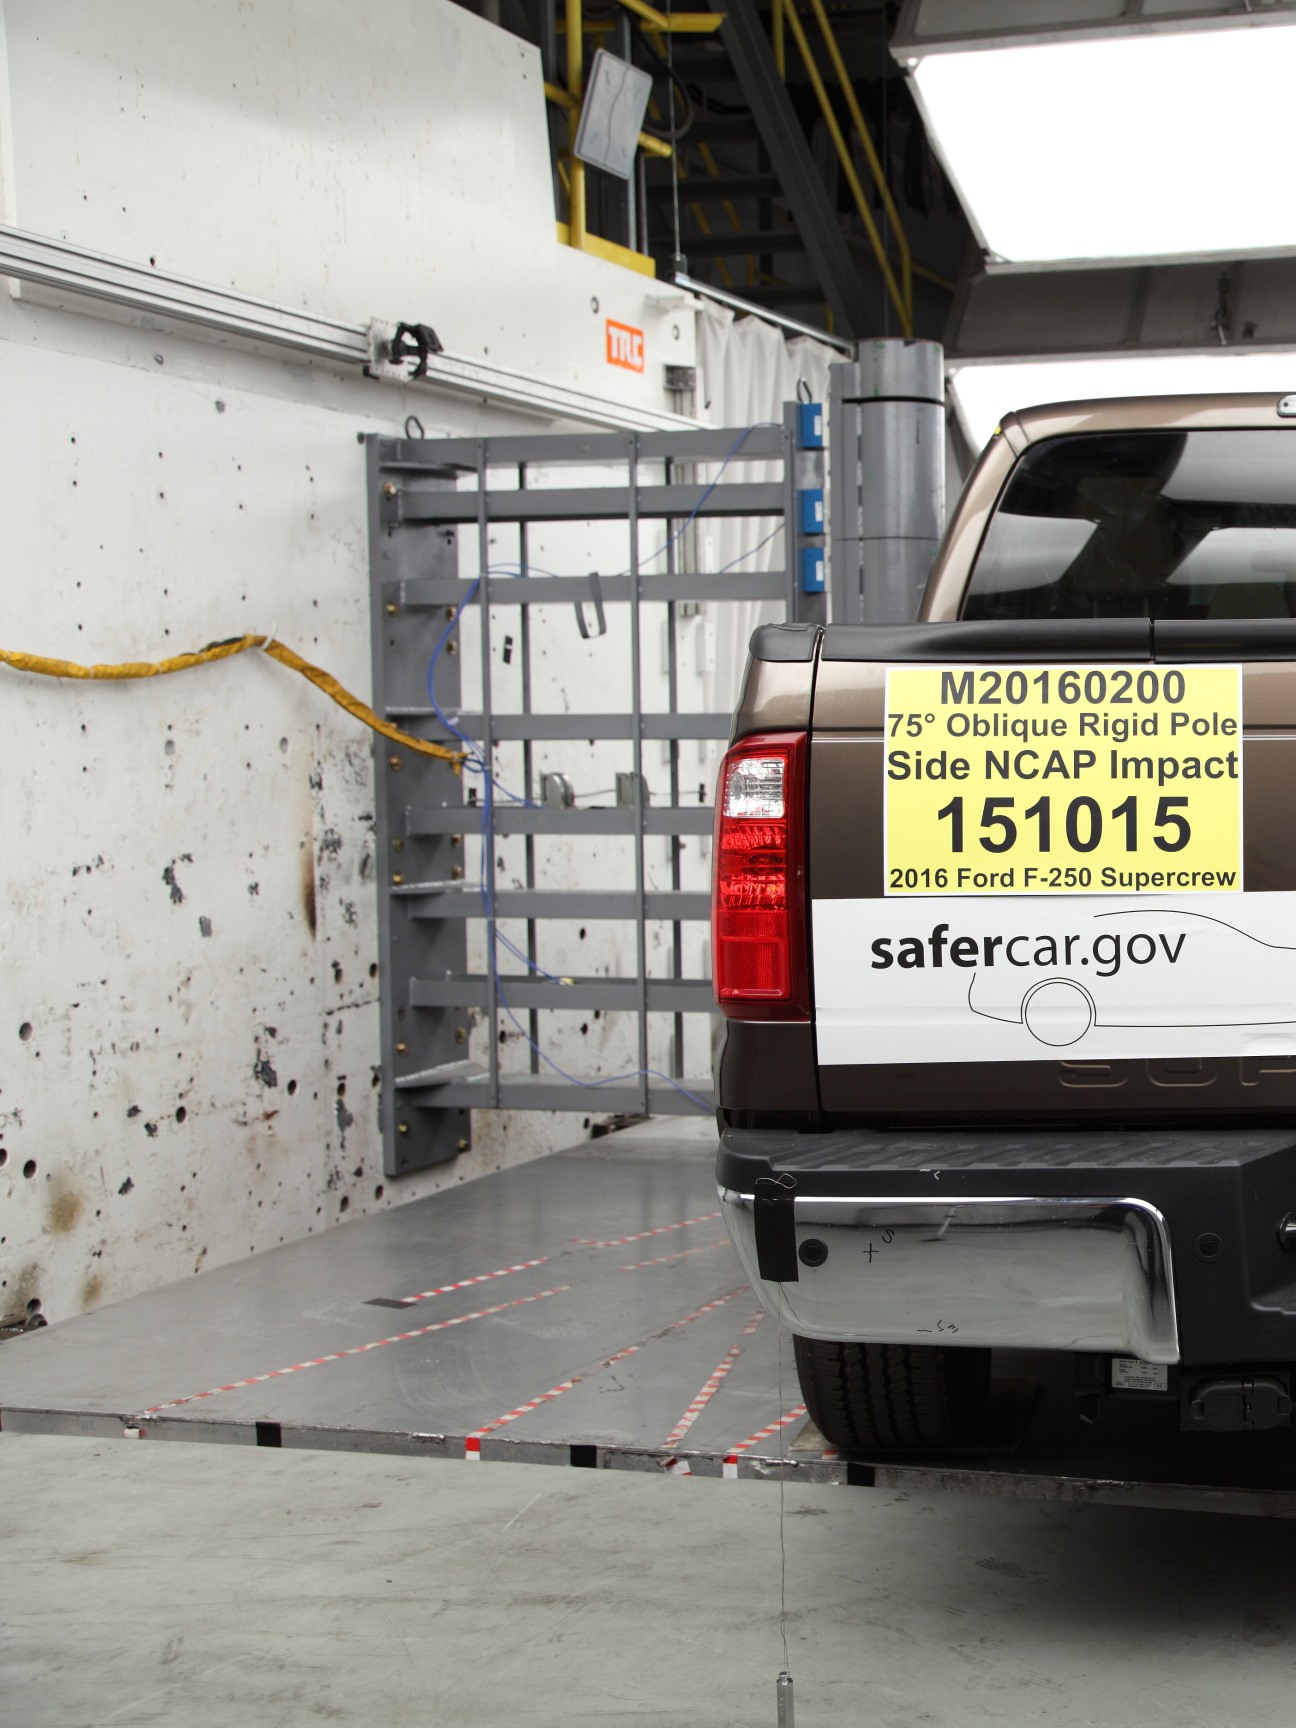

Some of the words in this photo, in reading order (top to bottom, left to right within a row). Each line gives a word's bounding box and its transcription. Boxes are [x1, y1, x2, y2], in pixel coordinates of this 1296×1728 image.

[942, 671, 1185, 704] M20160200
[889, 713, 935, 737] 75°
[947, 713, 1067, 742] Oblique
[1080, 713, 1157, 742] Rigid
[1172, 713, 1237, 736] Pole
[888, 751, 970, 780] Side
[986, 750, 1096, 779] NCAP
[1111, 750, 1238, 786] Impact
[938, 796, 1191, 853] 151015
[890, 868, 948, 888] 2016
[958, 868, 1013, 887] Ford
[1025, 868, 1091, 887] F-250
[1101, 867, 1236, 891] Supercrew
[871, 924, 1186, 976] safercar.gov
